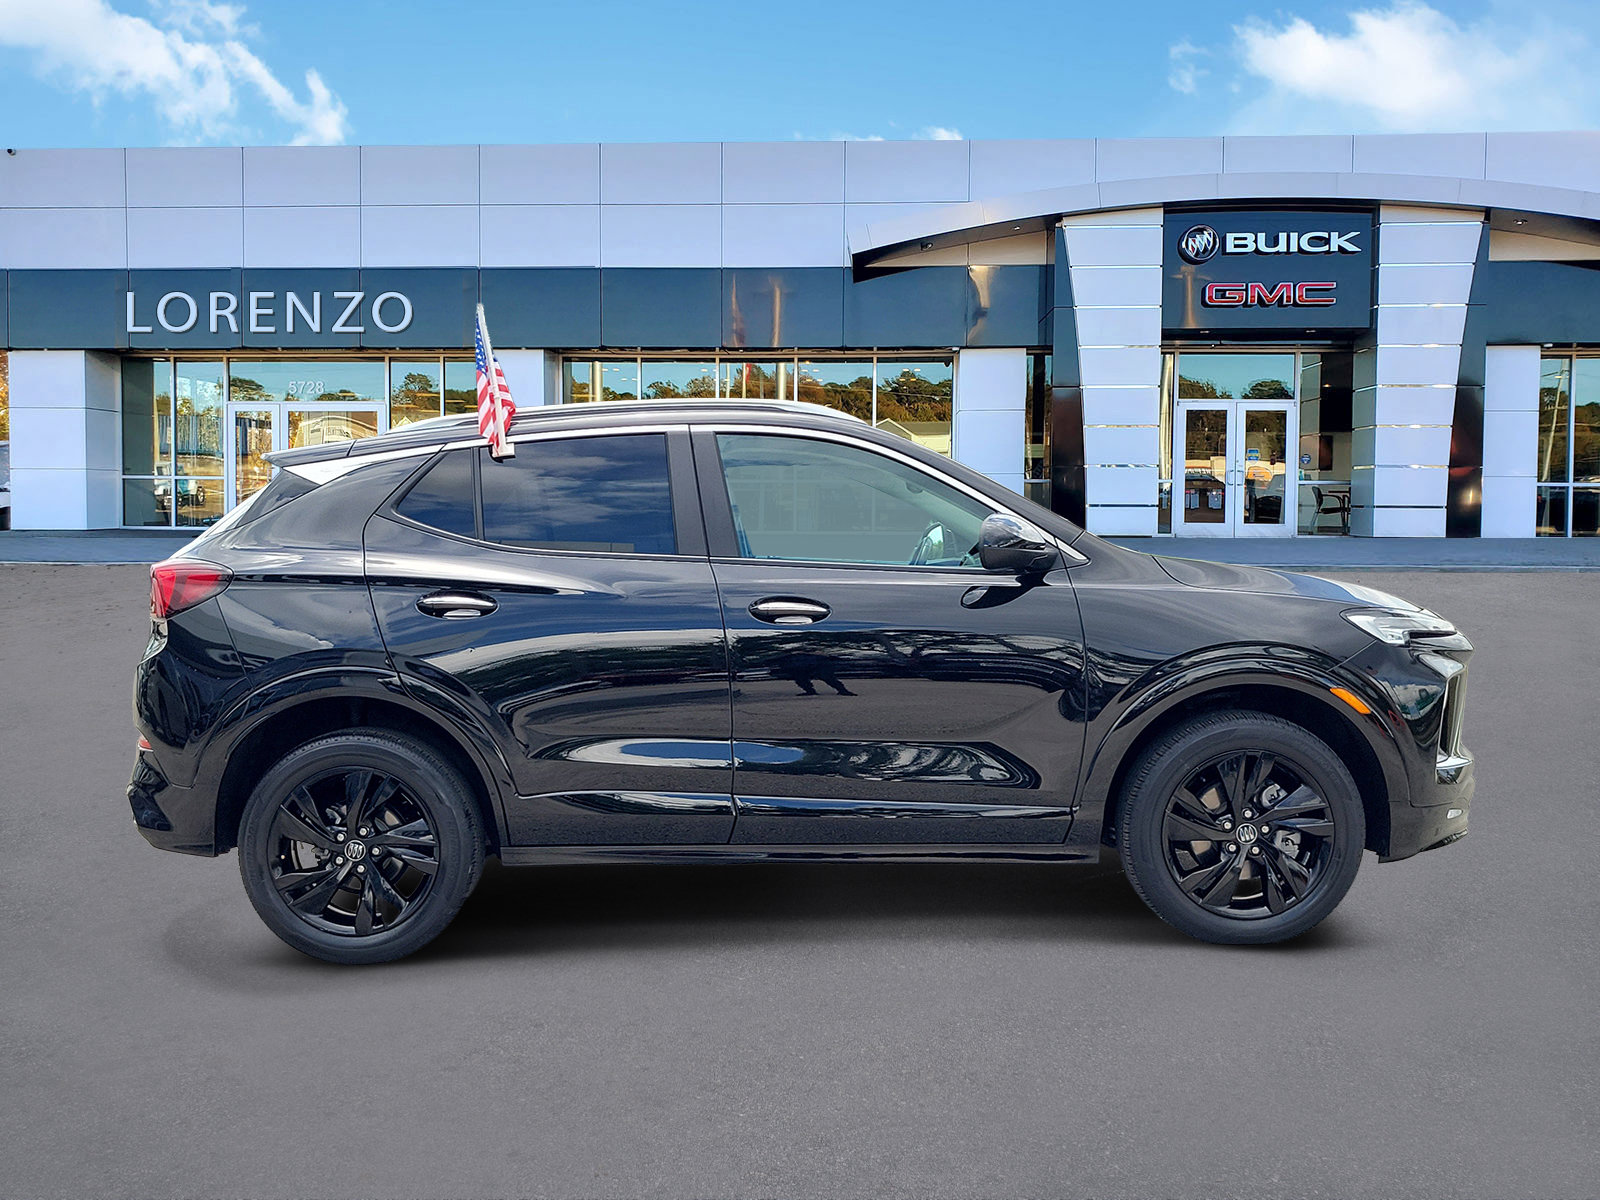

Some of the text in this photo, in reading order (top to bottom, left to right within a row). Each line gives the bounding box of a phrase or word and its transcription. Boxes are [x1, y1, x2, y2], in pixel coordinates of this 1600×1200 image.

[1225, 231, 1362, 253] BUICK
[1205, 282, 1337, 305] GMC
[126, 291, 414, 333] LORENZO
[288, 380, 325, 394] 5728
